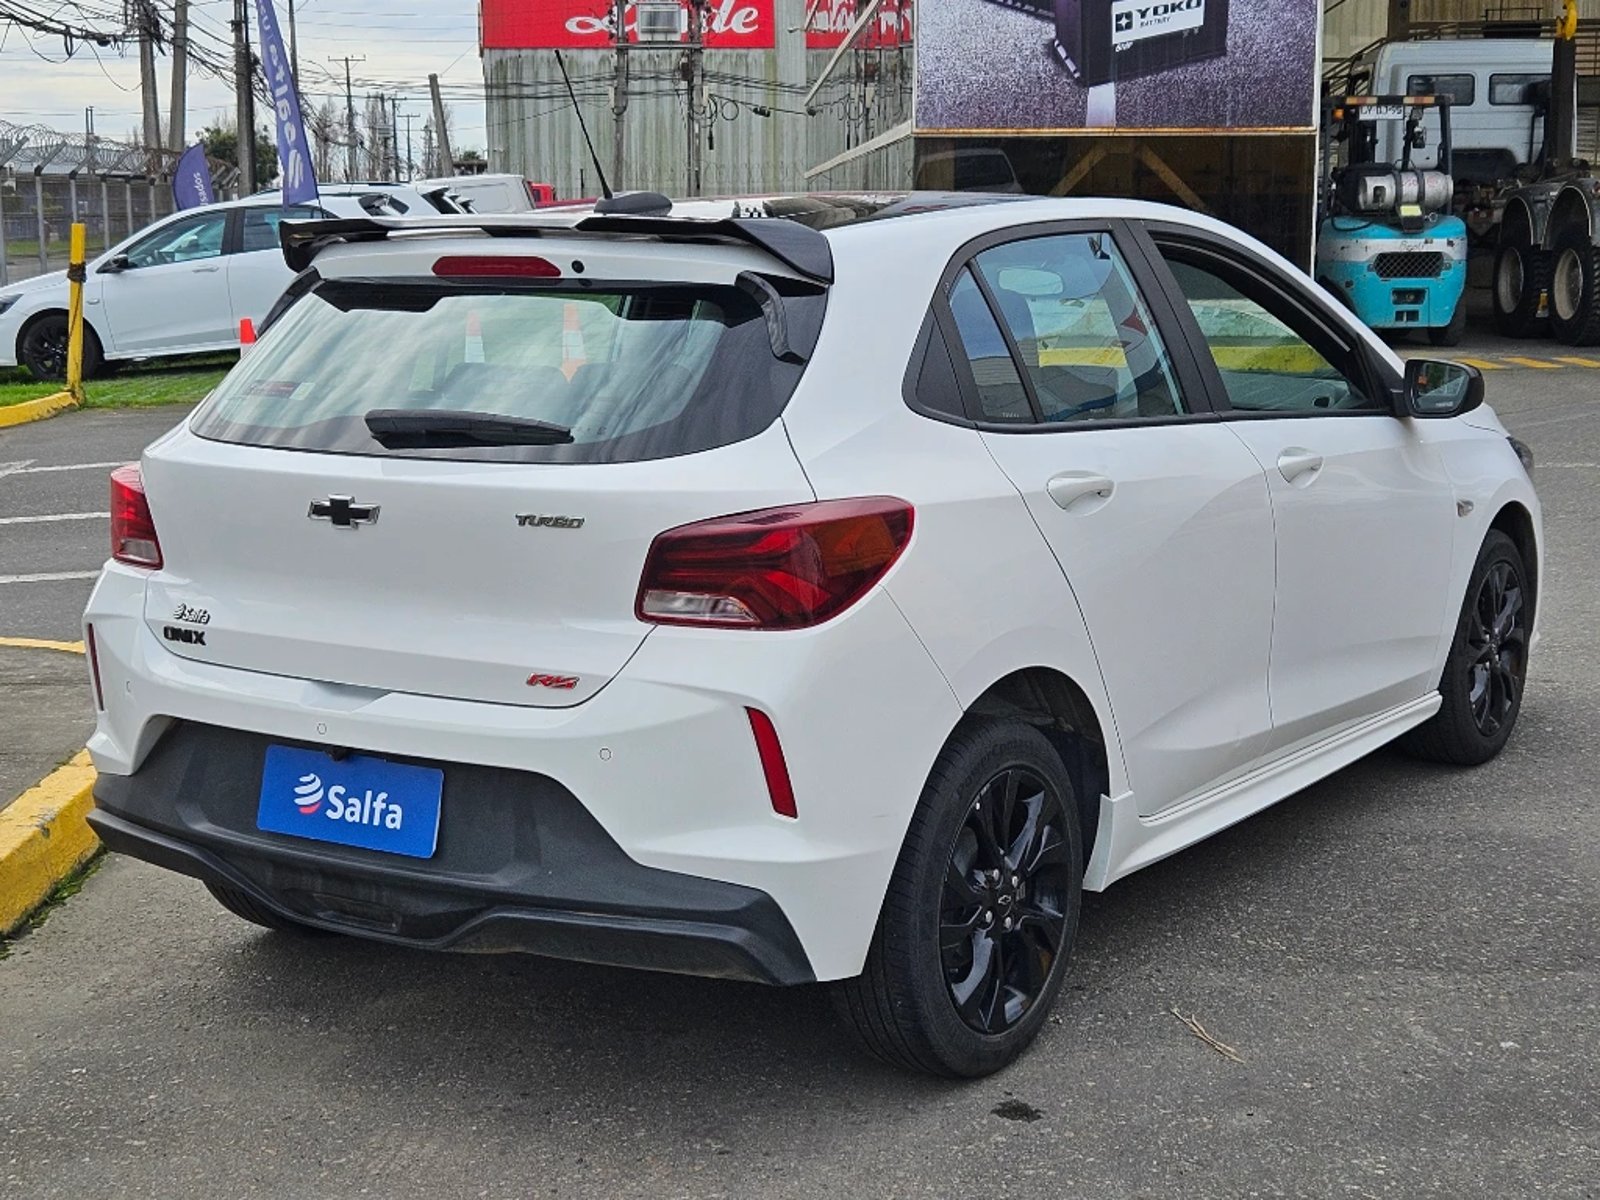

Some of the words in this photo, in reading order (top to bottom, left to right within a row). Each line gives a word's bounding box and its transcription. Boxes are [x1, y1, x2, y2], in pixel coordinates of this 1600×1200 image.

[565, 0, 759, 34] Lde
[1136, 0, 1202, 19] YOKO
[515, 513, 585, 529] TURBO
[183, 607, 210, 625] Salfa
[163, 626, 207, 646] ONIX
[526, 672, 580, 690] RS
[325, 785, 403, 831] Salfa
